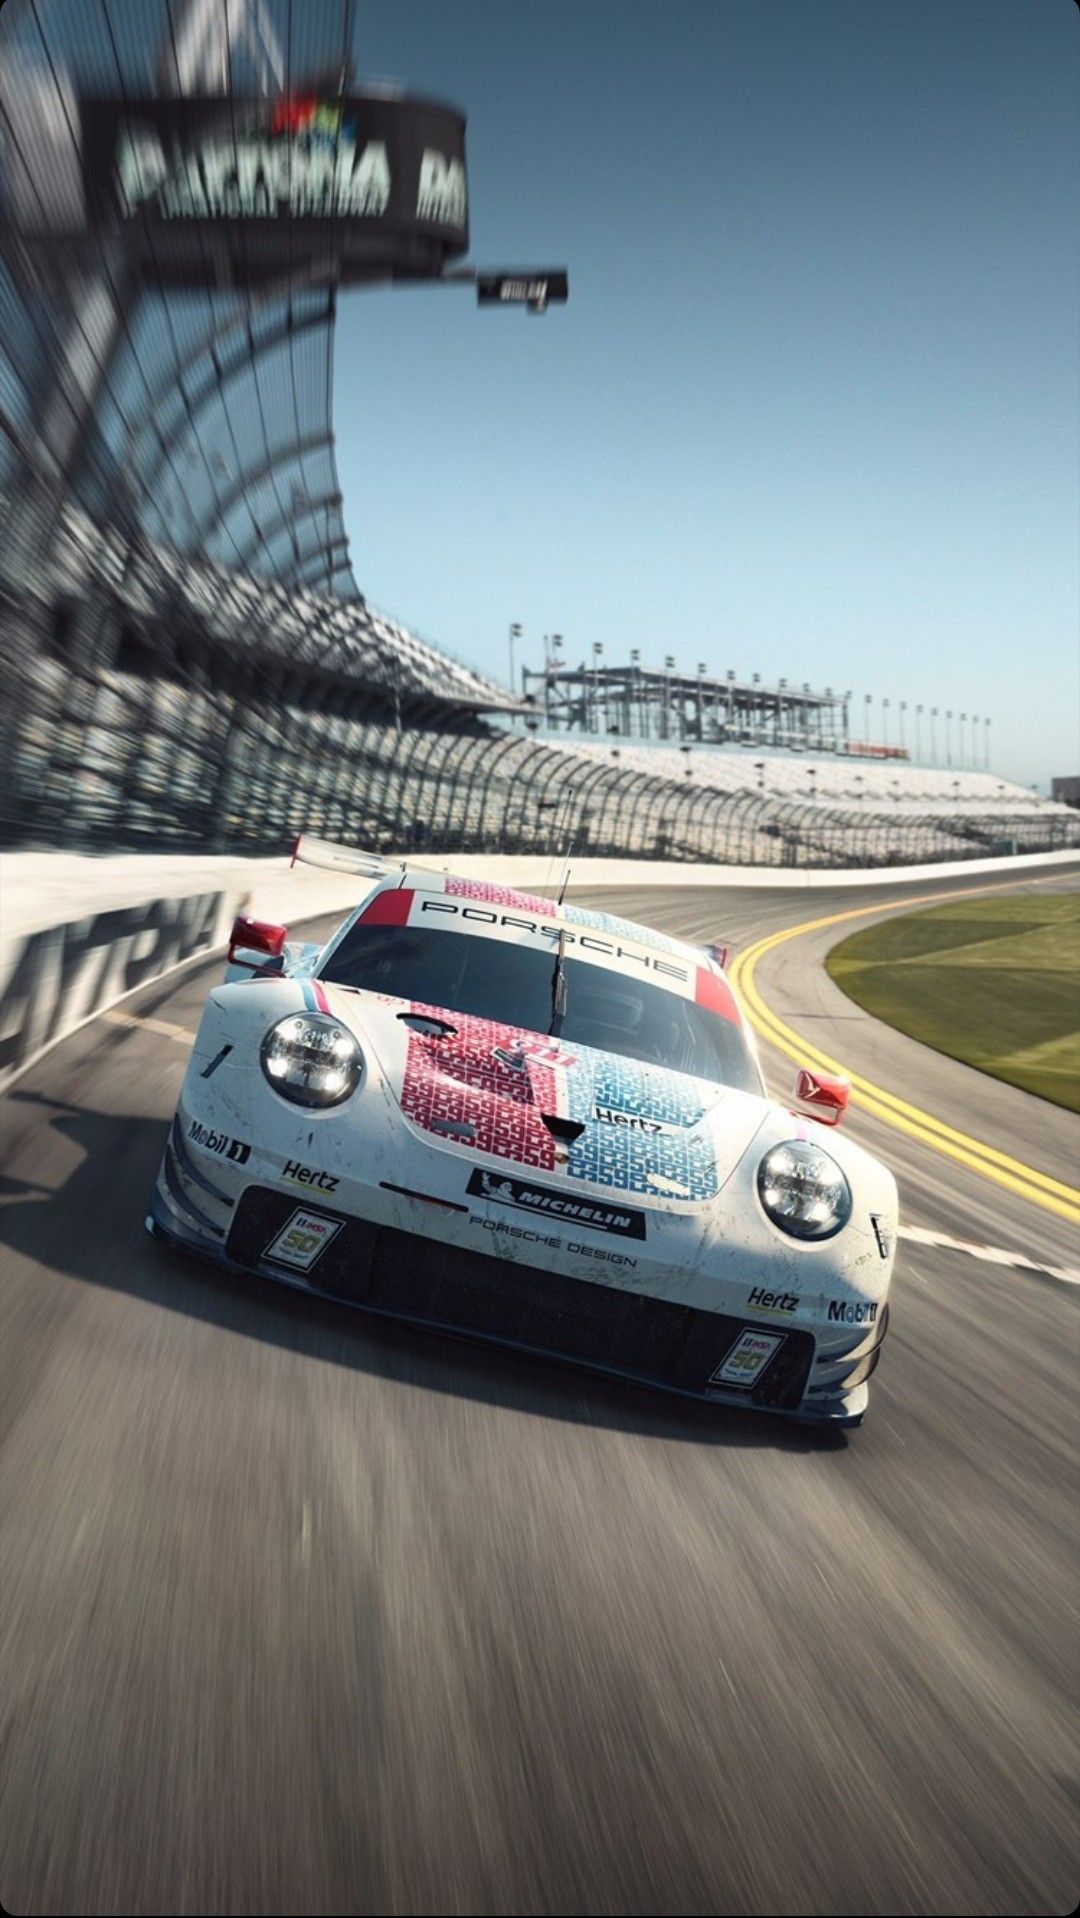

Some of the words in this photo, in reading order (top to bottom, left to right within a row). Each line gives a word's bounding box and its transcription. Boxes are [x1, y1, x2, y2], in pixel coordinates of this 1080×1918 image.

[421, 901, 688, 982] PORSCHE
[596, 1108, 662, 1133] Hertz
[188, 1121, 228, 1154] Mobil
[282, 1160, 340, 1192] Hertz
[518, 1191, 631, 1228] MICHELIN
[282, 1228, 321, 1253] 50
[469, 1216, 562, 1249] PORSCHE
[567, 1242, 637, 1268] DESIGN
[747, 1286, 800, 1312] Hertz
